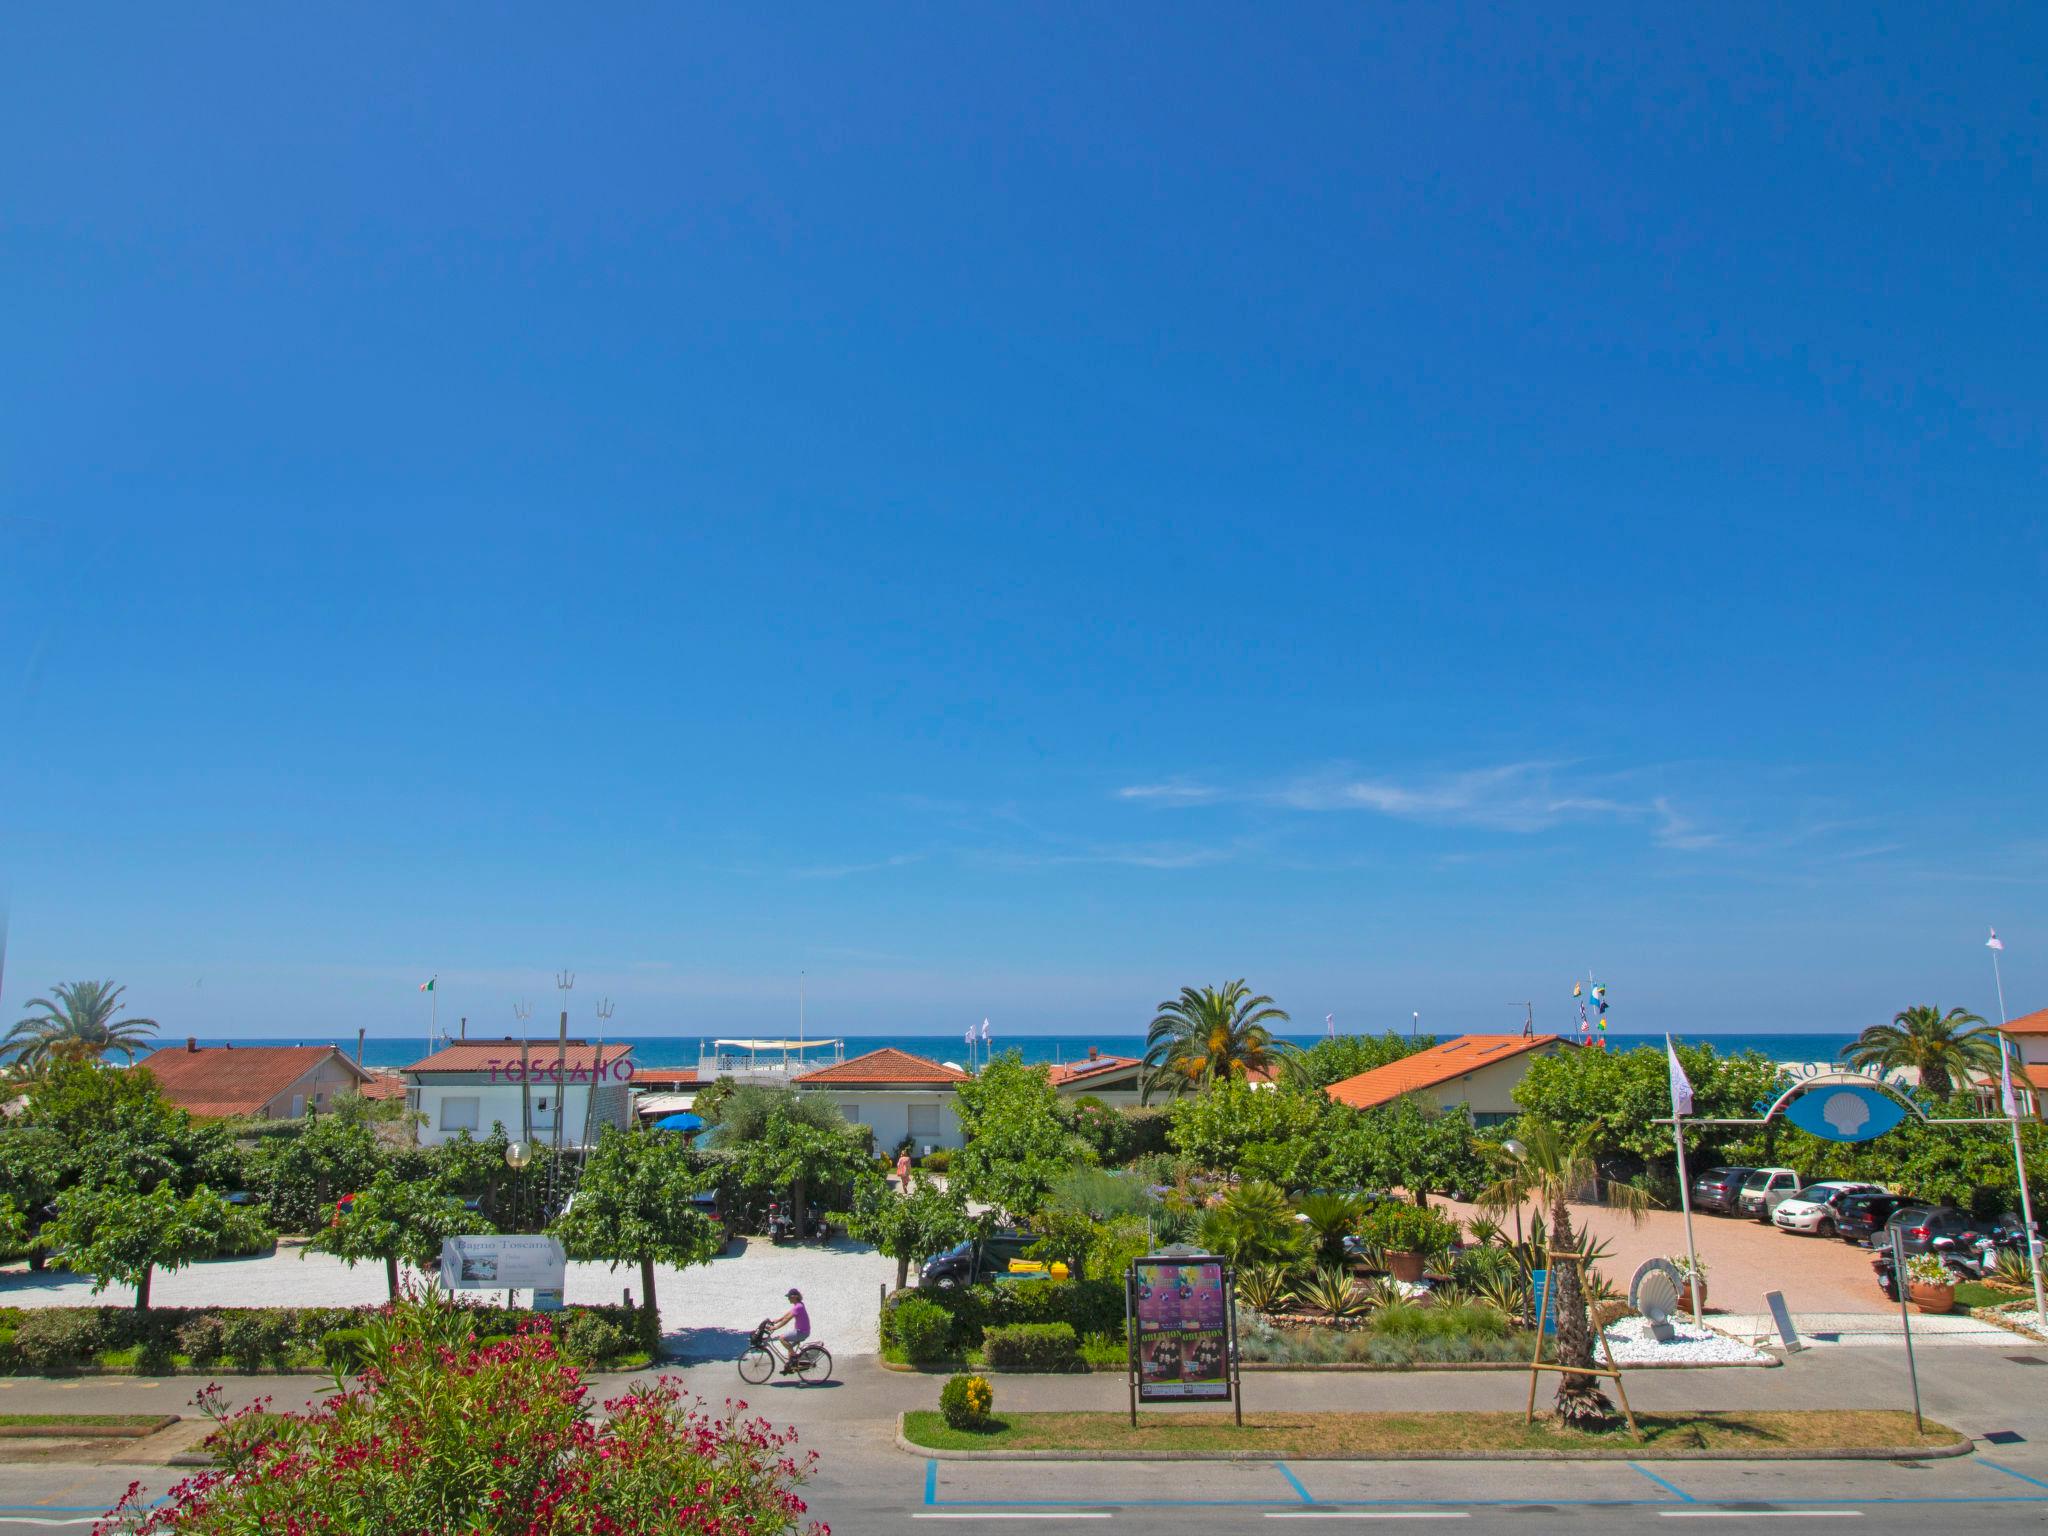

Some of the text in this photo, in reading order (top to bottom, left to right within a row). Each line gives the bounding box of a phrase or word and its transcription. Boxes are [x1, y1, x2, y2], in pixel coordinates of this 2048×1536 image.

[488, 1059, 635, 1082] TOSCANO
[1752, 1062, 1818, 1113] BAGNO
[458, 1240, 551, 1250] Bagno Toscano
[1141, 1330, 1182, 1342] OBLIVION
[1182, 1329, 1223, 1341] OBLIVION
